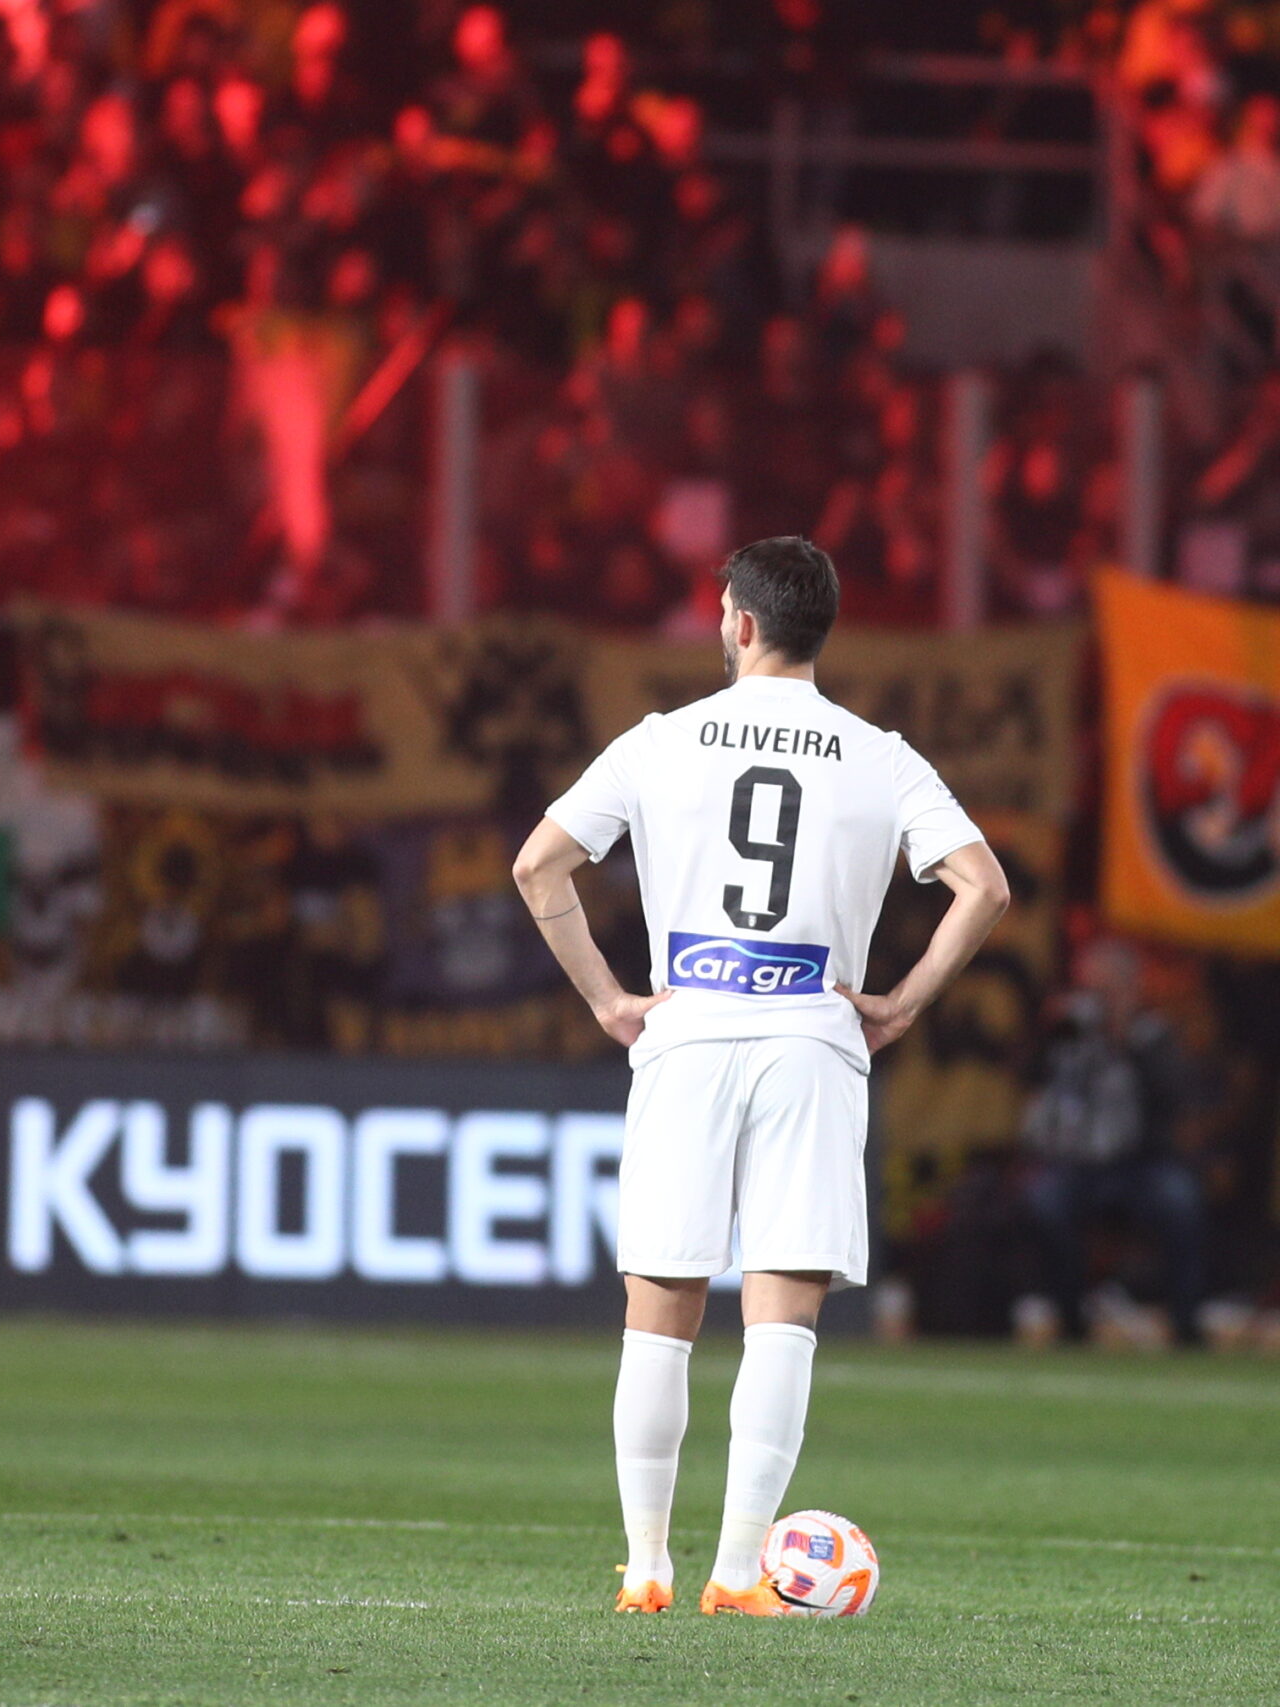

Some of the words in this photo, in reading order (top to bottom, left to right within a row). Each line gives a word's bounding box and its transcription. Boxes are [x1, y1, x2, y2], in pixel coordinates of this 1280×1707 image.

[699, 721, 843, 762] OLIVEIRA
[723, 765, 803, 932] 9
[8, 1097, 741, 1290] KYOCER
